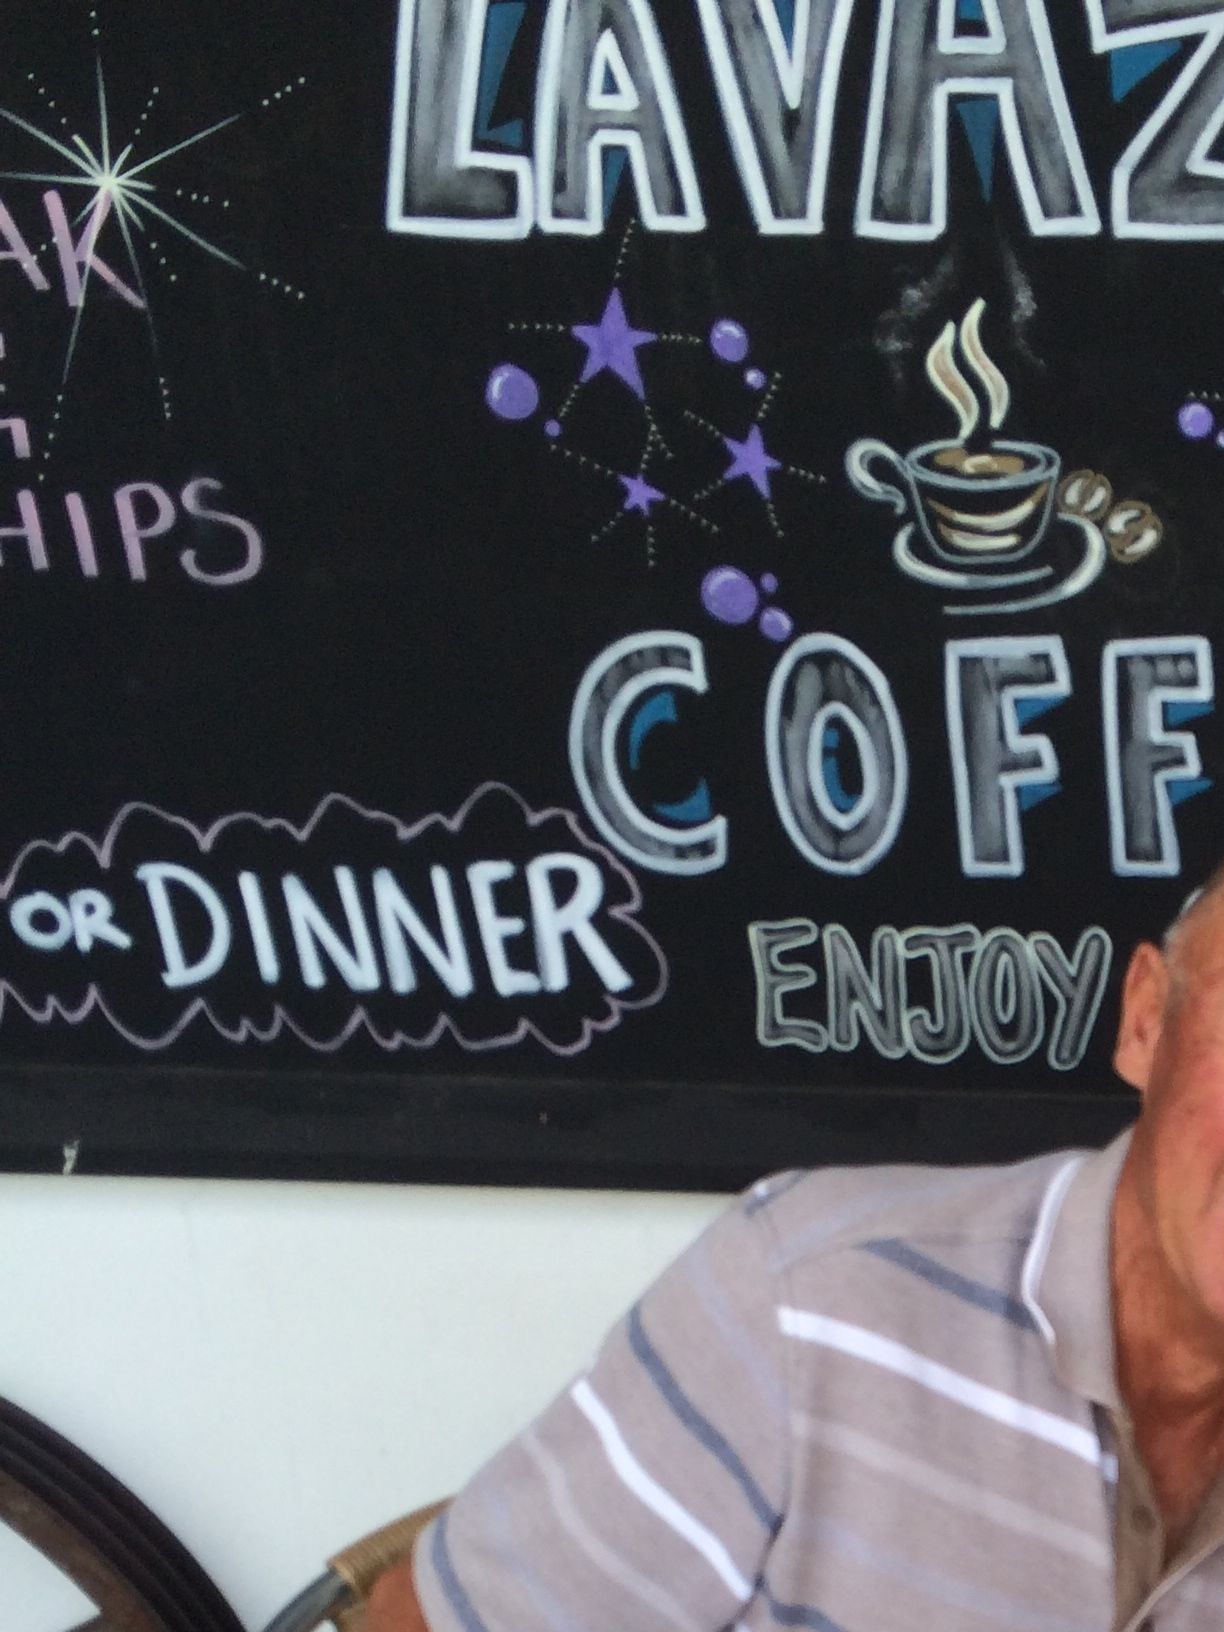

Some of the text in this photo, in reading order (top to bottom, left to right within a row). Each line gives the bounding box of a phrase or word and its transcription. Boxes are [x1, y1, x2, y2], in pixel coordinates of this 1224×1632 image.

[10, 852, 634, 997] OR DINNER
[749, 919, 1111, 1071] ENJOY
